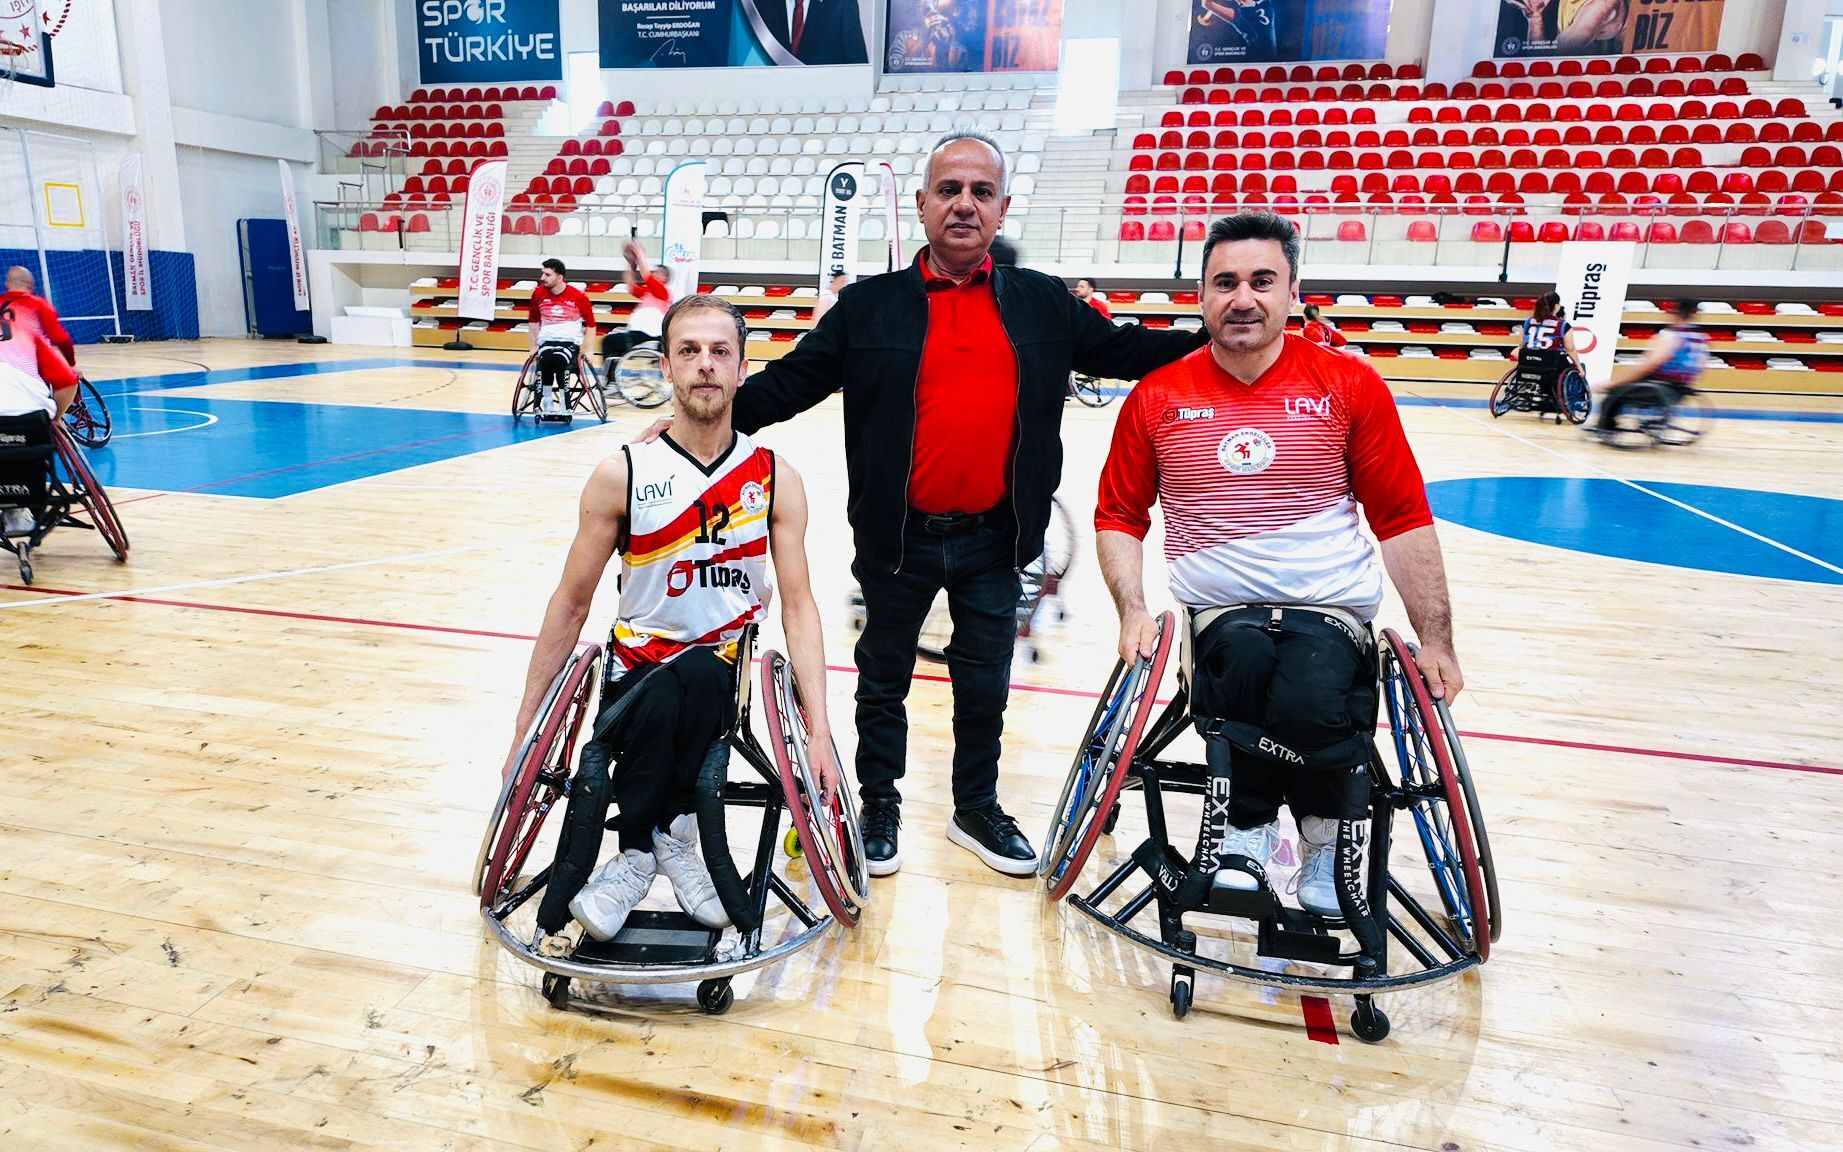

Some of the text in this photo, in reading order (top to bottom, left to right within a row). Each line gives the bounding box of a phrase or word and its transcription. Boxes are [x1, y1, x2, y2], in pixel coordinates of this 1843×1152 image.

[423, 0, 506, 26] SPOR
[622, 1, 715, 13] BAŞARILAR DİLİYORUM
[425, 29, 555, 63] TÜRKİYE
[1633, 9, 1674, 50] BİZ
[476, 213, 485, 227] VE
[832, 205, 847, 259] BATMAN
[471, 228, 484, 272] GENÇLİK
[482, 211, 496, 297] SPOR BAKANLIĞI
[1573, 263, 1606, 320] Tüpraş
[1527, 326, 1555, 349] 15
[1178, 407, 1215, 420] Tüpraş
[694, 500, 729, 545] 12
[1259, 737, 1304, 764] EXTRA
[1199, 802, 1211, 874] WHEELCHAIR
[1207, 777, 1230, 874] EXTRA
[1343, 847, 1368, 917] WHEELCHAIR
